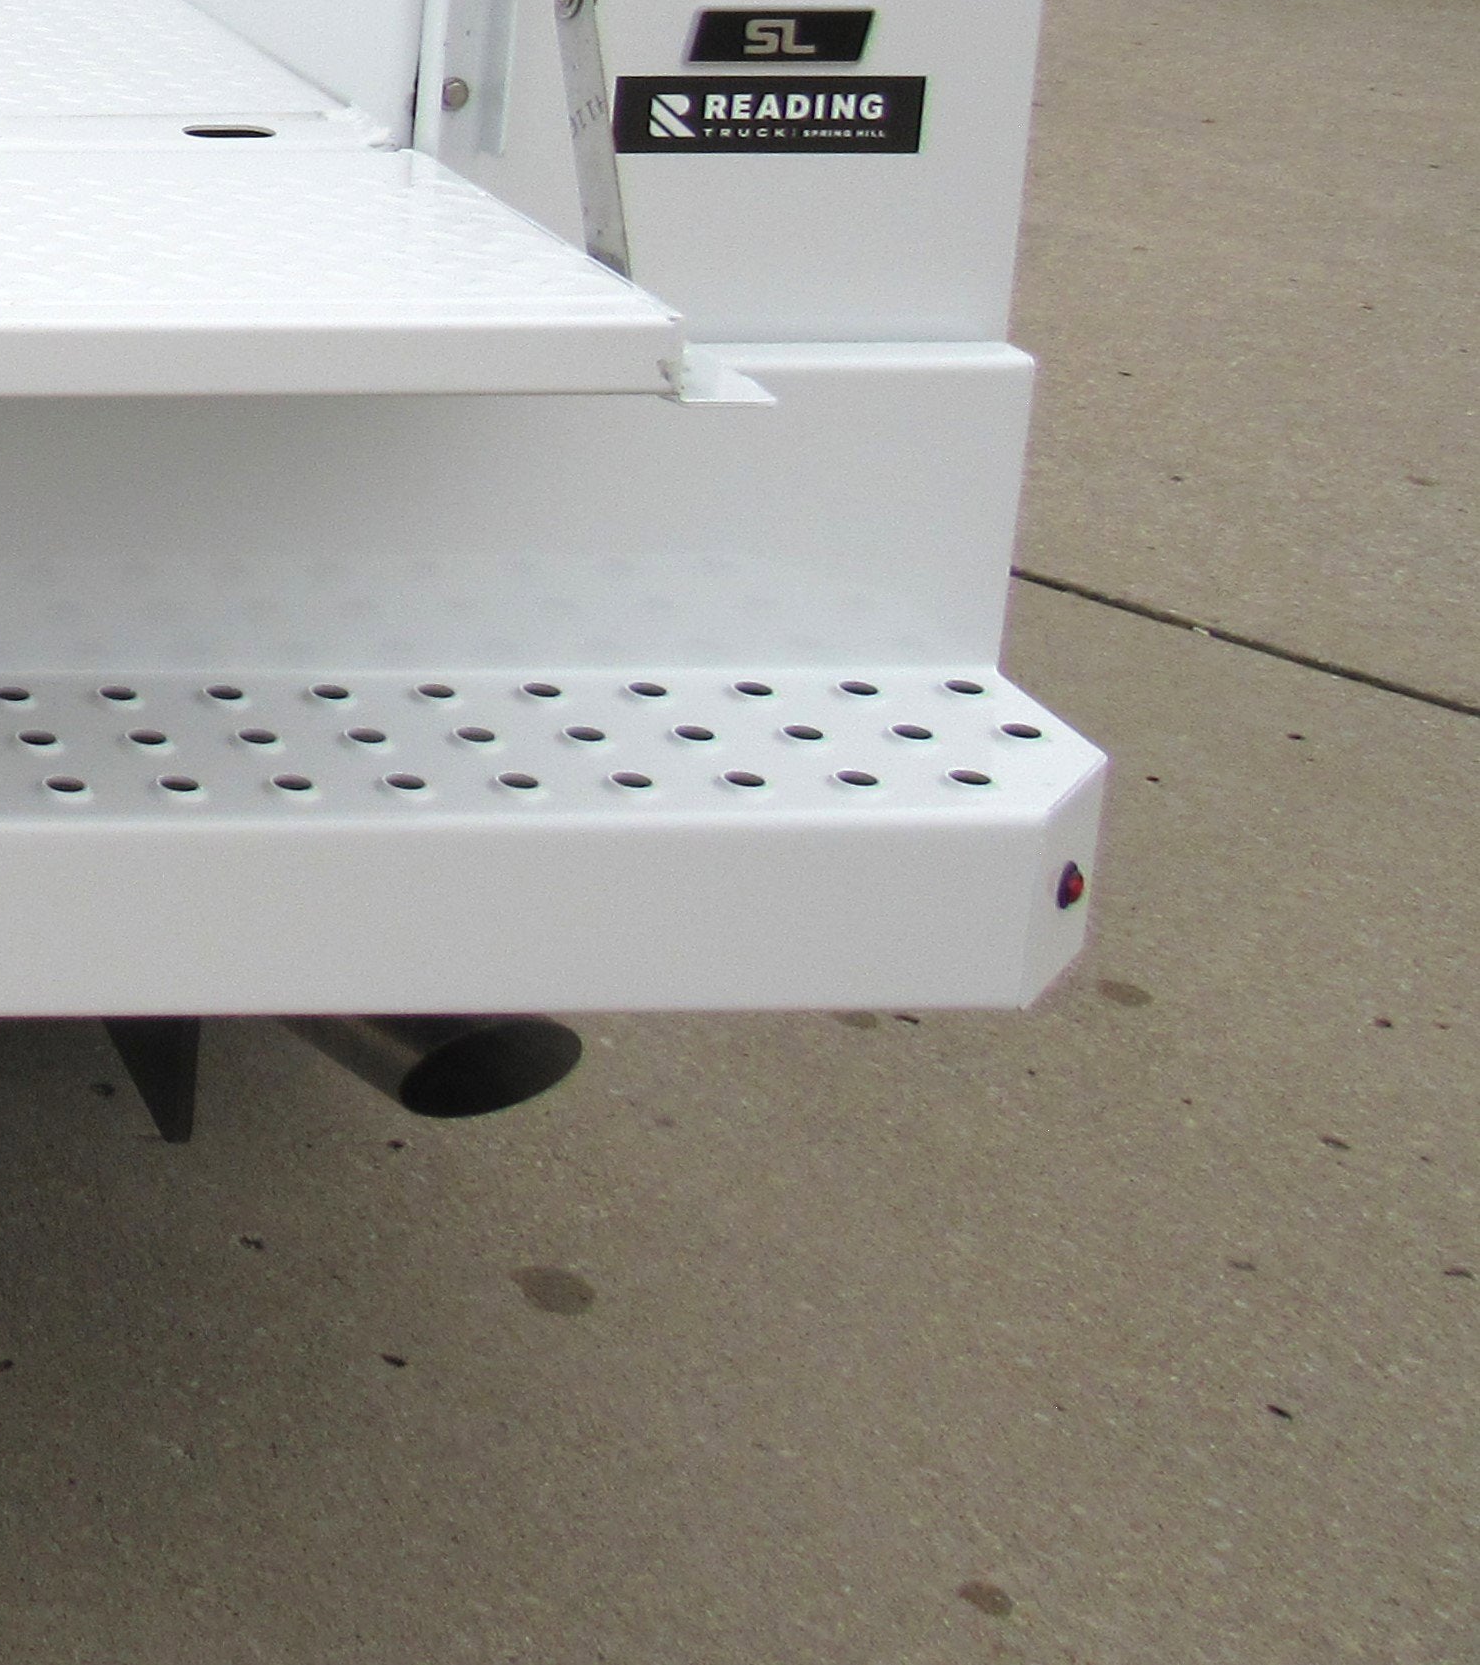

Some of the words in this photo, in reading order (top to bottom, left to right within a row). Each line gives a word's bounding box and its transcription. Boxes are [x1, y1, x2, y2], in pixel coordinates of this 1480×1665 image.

[743, 19, 816, 54] SL
[703, 93, 884, 121] READING
[702, 128, 786, 138] TRUCK
[802, 129, 853, 138] SPRING
[855, 129, 886, 138] HILL
